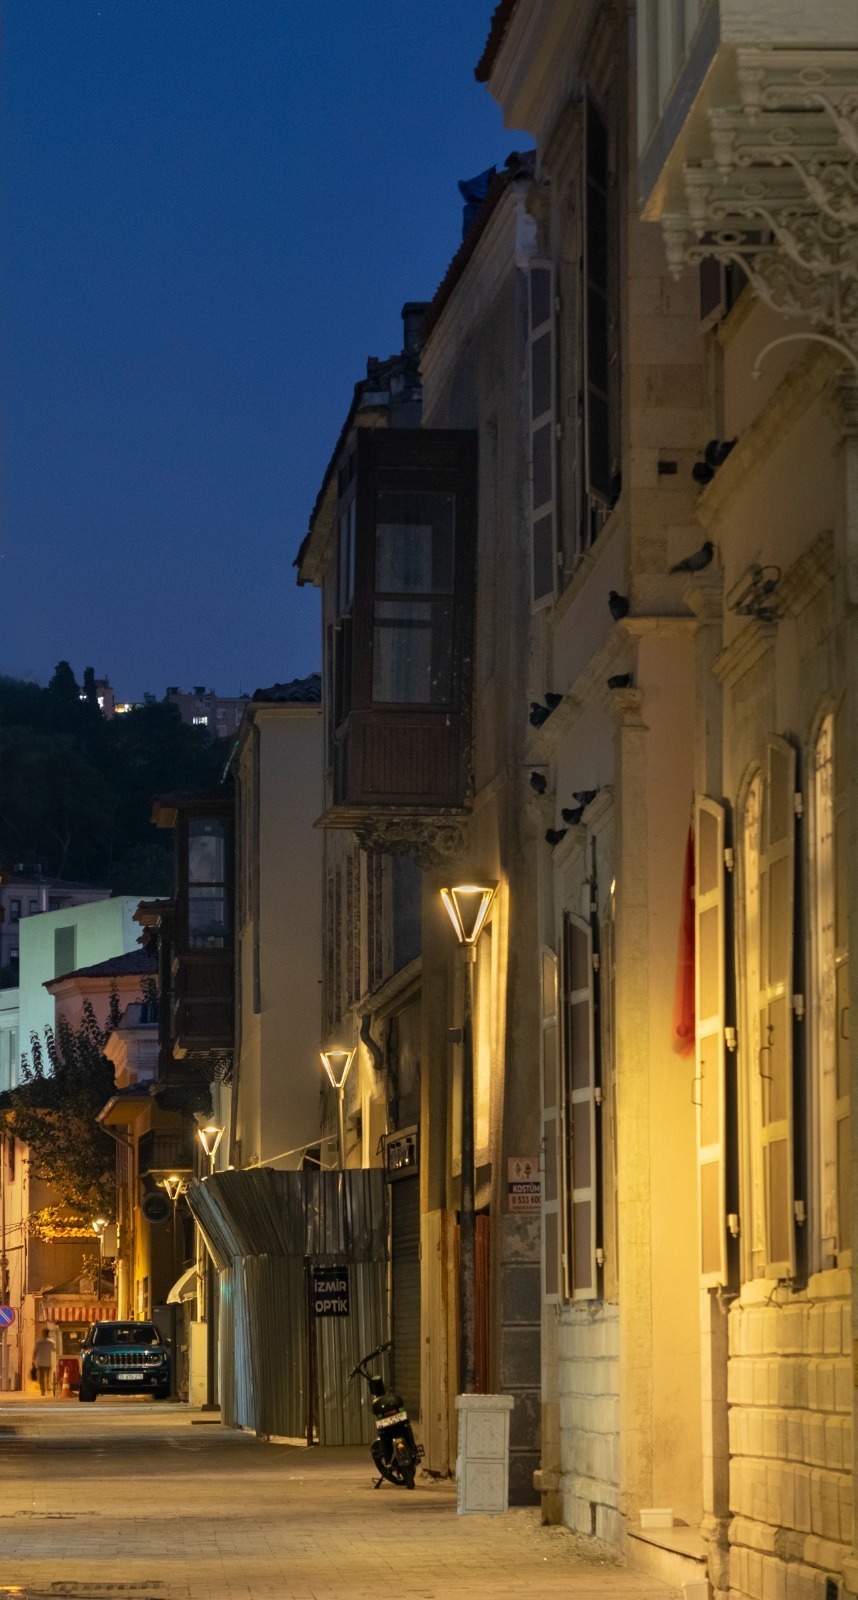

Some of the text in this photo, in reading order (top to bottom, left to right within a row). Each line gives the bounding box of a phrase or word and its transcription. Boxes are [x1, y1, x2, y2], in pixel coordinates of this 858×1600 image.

[511, 1196, 516, 1204] 0
[314, 1278, 347, 1292] İZMİR
[315, 1296, 348, 1312] OPTİK
